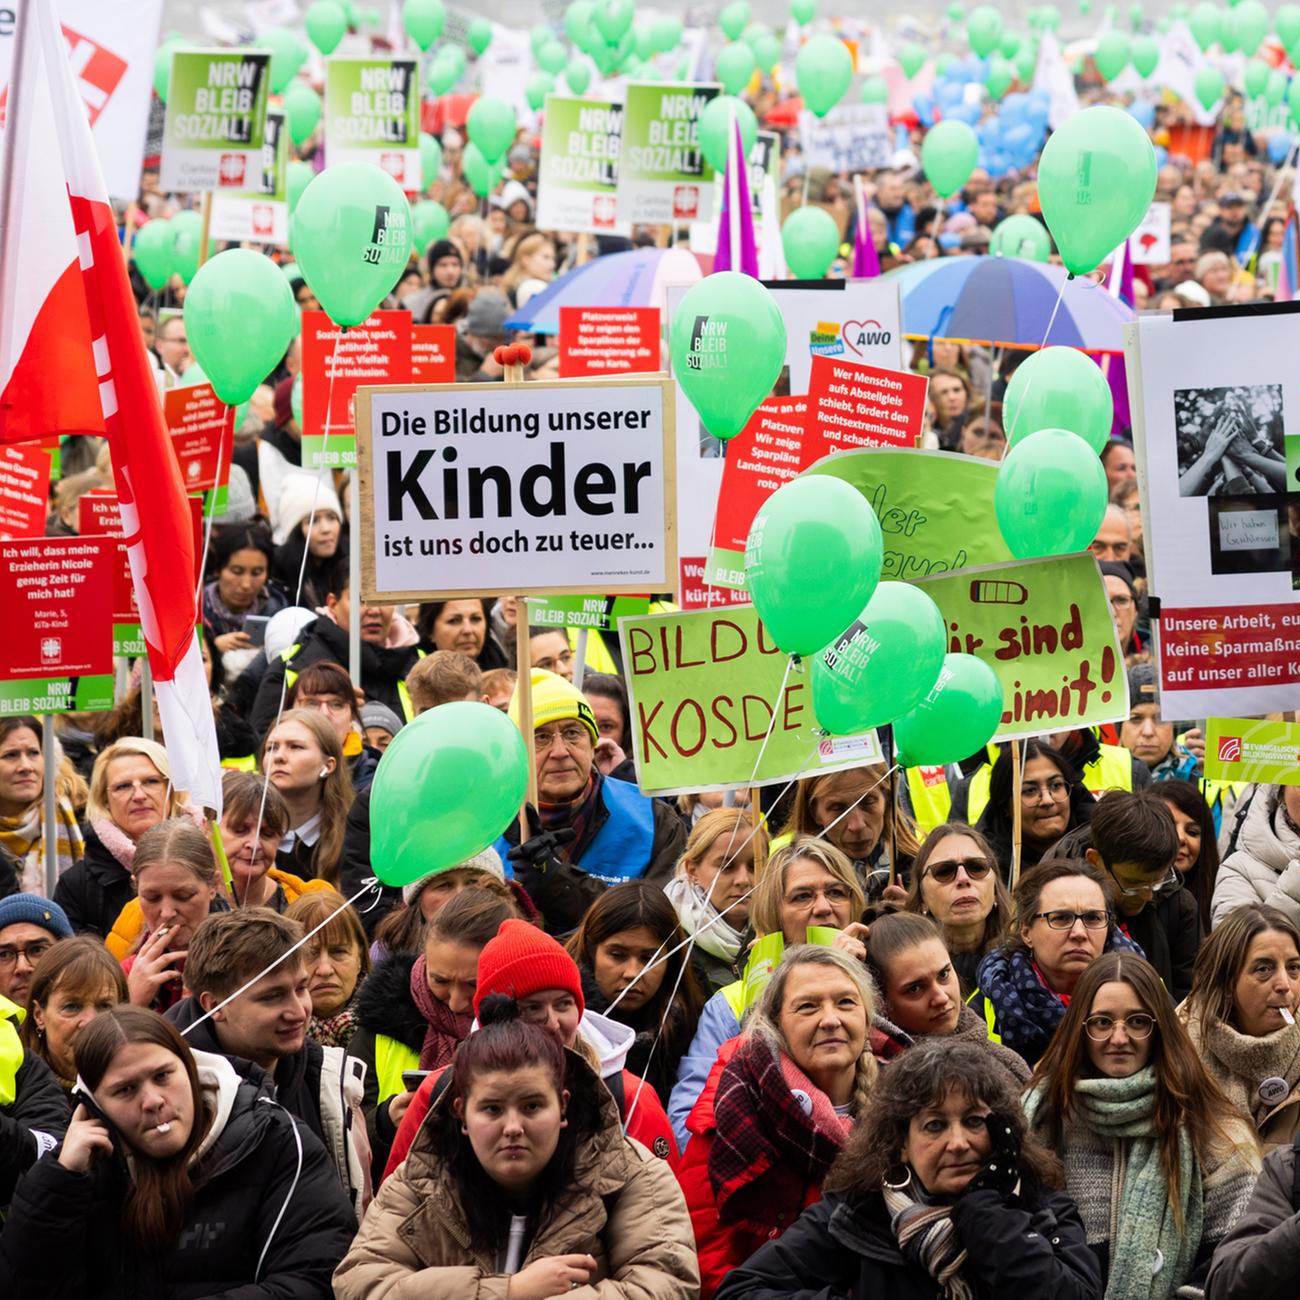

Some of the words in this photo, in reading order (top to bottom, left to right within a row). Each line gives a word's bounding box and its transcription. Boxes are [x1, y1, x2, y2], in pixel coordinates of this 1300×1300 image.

[208, 62, 256, 87] NRW
[360, 68, 406, 93] NRW
[196, 88, 253, 113] BLEIB
[351, 92, 406, 116] BLEIB
[660, 95, 707, 119] NRW
[174, 114, 250, 141] SOZIAL!
[334, 117, 406, 142] SOZIAL!
[579, 108, 623, 134] NRW
[568, 131, 622, 157] BLEIB
[629, 148, 701, 173] SOZIAL!
[700, 321, 728, 336] NRW
[856, 331, 891, 346] AWO
[694, 337, 727, 352] BLEIB
[686, 354, 728, 370] SOZIAL!
[833, 367, 853, 380] Wer
[855, 371, 903, 391] Menschen
[828, 382, 849, 396] aufs
[851, 387, 903, 407] Abstellgleis
[819, 397, 855, 414] schiebt,
[856, 402, 889, 420] fördert
[891, 411, 909, 423] den
[381, 411, 427, 437] Die
[434, 406, 540, 439] Bildung
[548, 409, 652, 431] unserer
[817, 411, 907, 438] Rechtsextremismus
[755, 433, 773, 443] Wir
[823, 429, 842, 441] und
[843, 432, 879, 448] schadet
[386, 441, 652, 523] Kinder
[757, 480, 779, 490] rote
[3, 548, 18, 558] Ich
[20, 547, 41, 558] will,
[44, 546, 65, 556] dass
[68, 545, 99, 555] meine
[384, 533, 413, 557] ist
[420, 535, 463, 556] uns
[469, 529, 528, 554] doch
[535, 534, 563, 552] zu
[570, 530, 654, 552] teuer...
[9, 560, 59, 572] Erzieherin
[62, 559, 93, 570] Nicole
[716, 568, 745, 585] BLEIB
[17, 577, 47, 588] genug
[49, 574, 69, 584] Zeit
[70, 573, 85, 583] für
[28, 589, 53, 599] mich
[54, 588, 75, 598] hat!
[534, 609, 565, 624] BLEIB
[567, 611, 606, 627] SOZIAL!
[583, 599, 608, 613] NRW
[945, 623, 985, 655] ir
[998, 603, 1084, 662] sind
[1164, 616, 1217, 632] Unsere
[1223, 612, 1276, 630] Arbeit,
[630, 617, 780, 676] BILDU
[850, 629, 881, 655] NRW
[1166, 641, 1209, 657] Keine
[823, 647, 862, 685] SOZIAL!
[837, 639, 870, 670] BLEIB
[1167, 666, 1194, 682] auf
[1199, 668, 1242, 680] unser
[1248, 661, 1283, 678] aller
[48, 683, 72, 695] NRW
[1, 698, 29, 712] BLEIB
[33, 696, 72, 711] SOZIAL!
[637, 683, 806, 765] KOSDE
[1267, 1084, 1285, 1097] AWO
